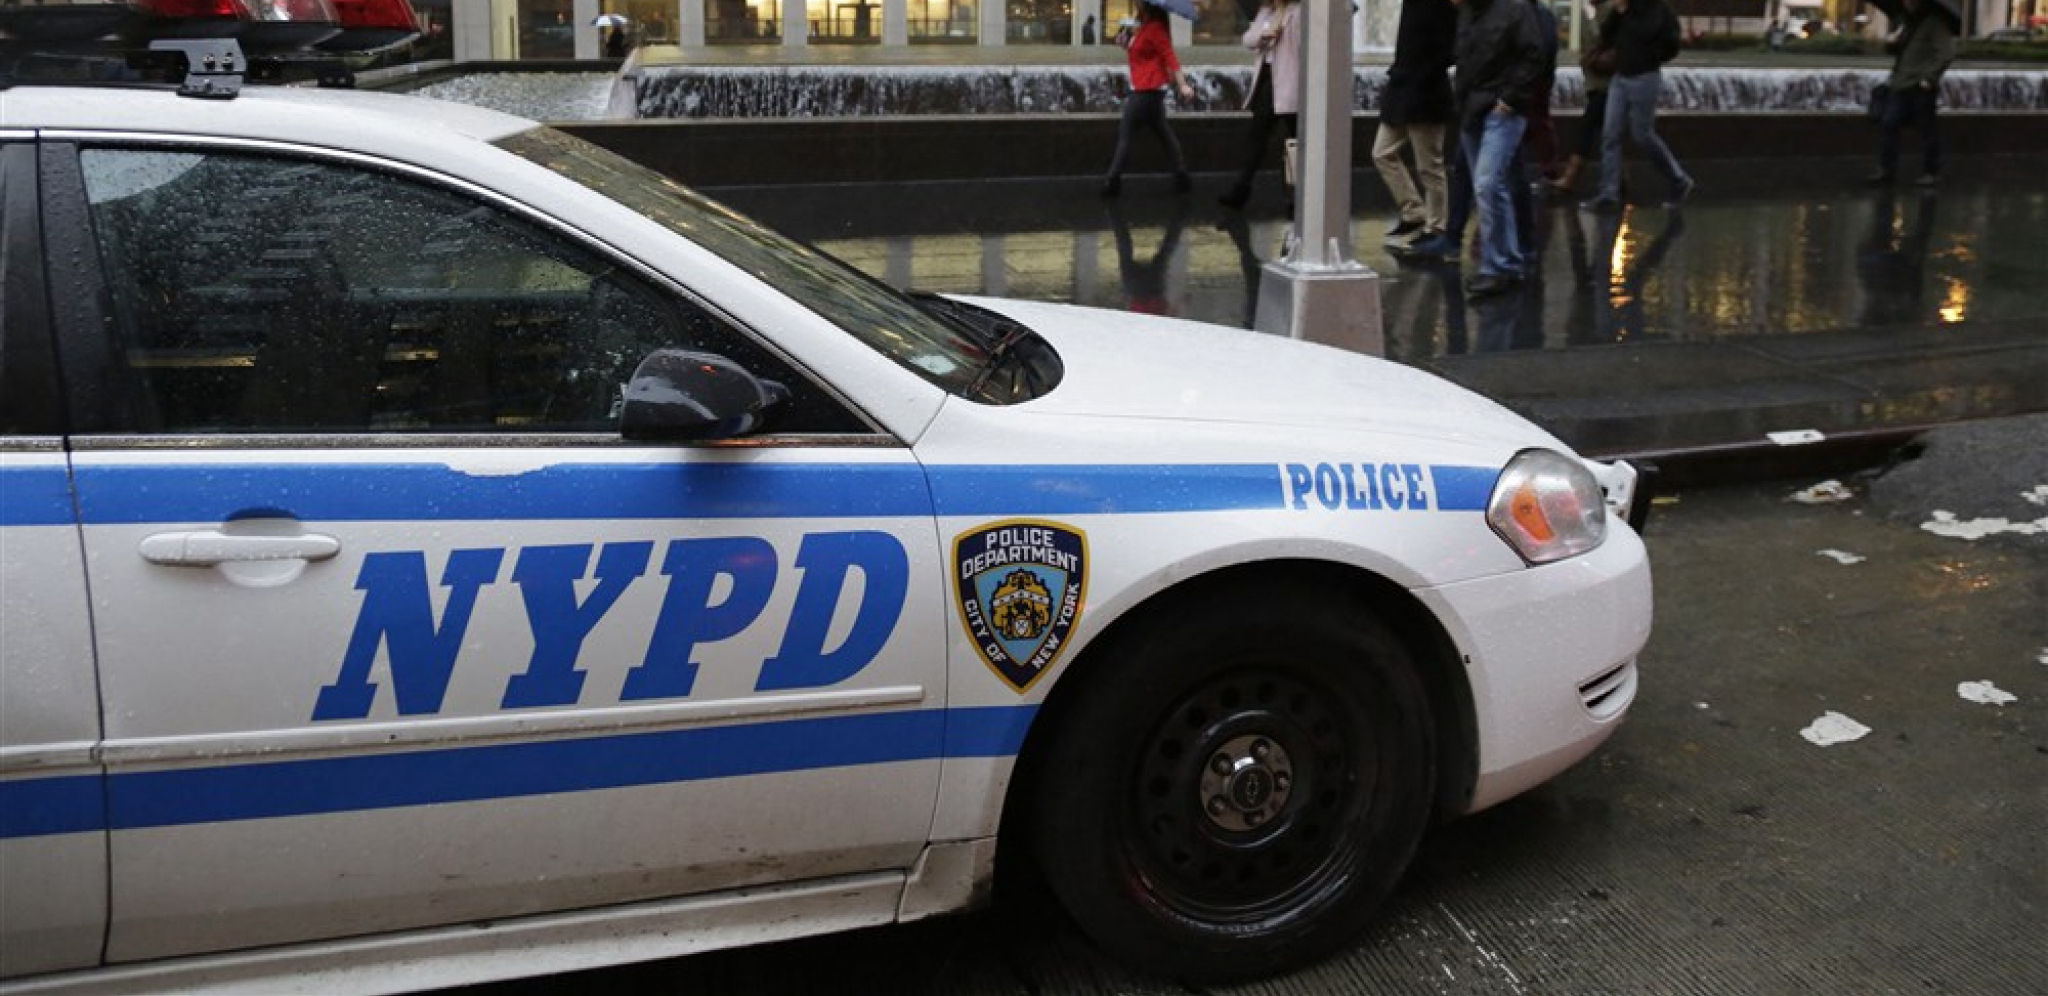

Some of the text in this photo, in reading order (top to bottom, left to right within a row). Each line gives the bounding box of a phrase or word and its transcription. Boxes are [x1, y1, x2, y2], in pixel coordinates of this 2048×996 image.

[1285, 462, 1428, 510] POLICE
[962, 546, 1078, 579] DEPARTMENT
[986, 528, 1054, 549] POLICE
[311, 529, 910, 721] NYPD
[964, 583, 1080, 669] CITY OF NEW YORK
